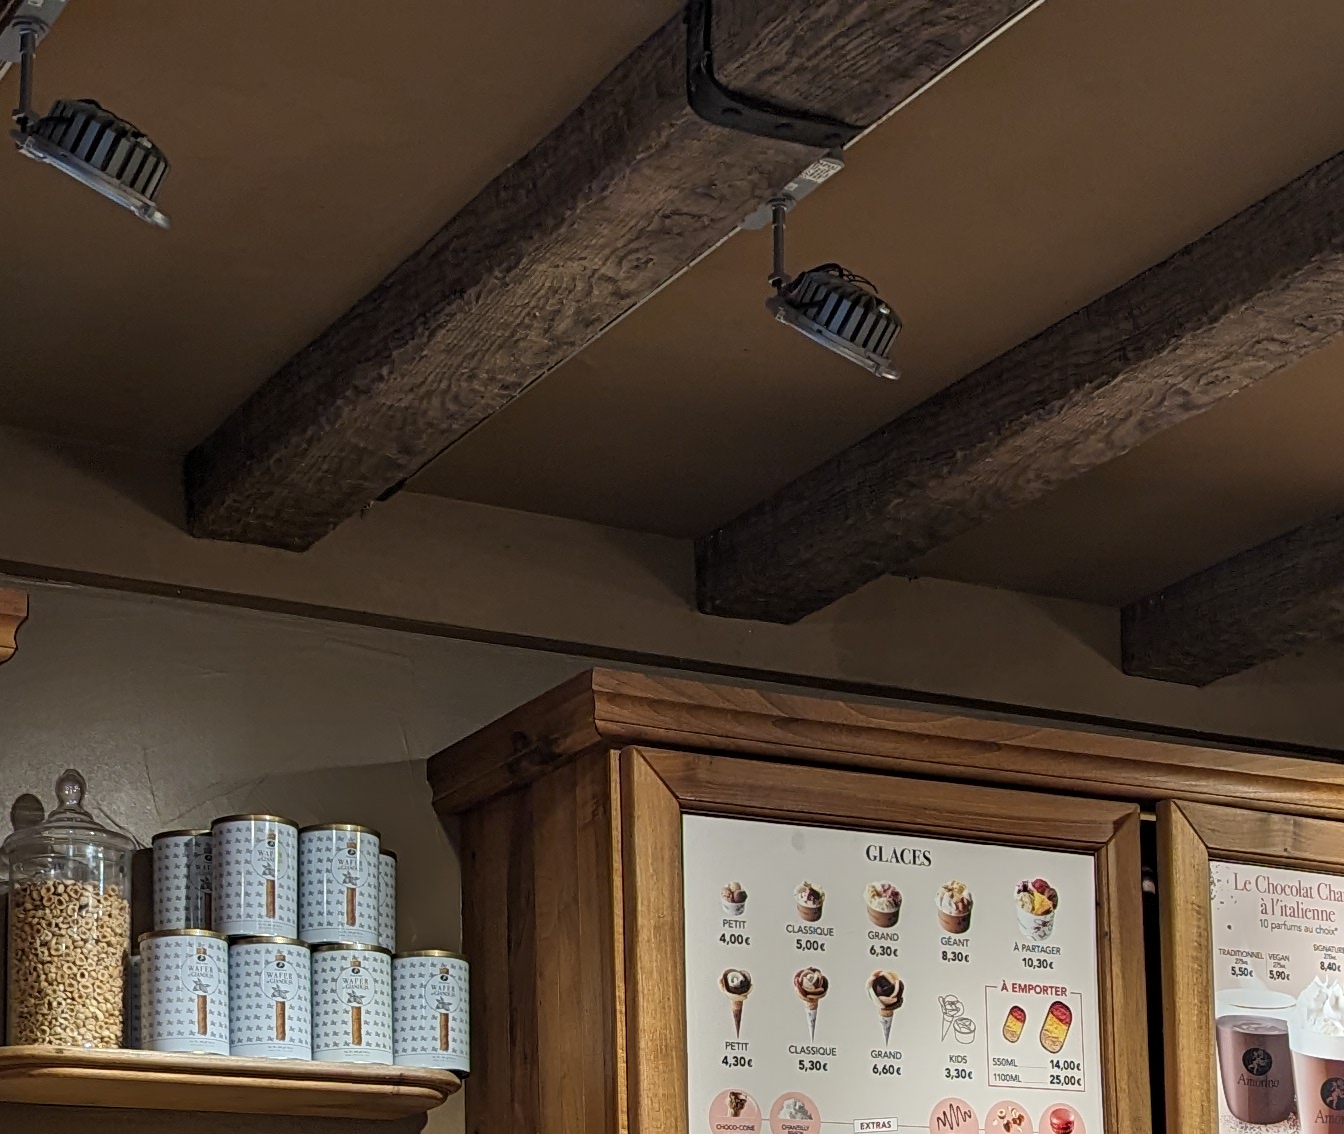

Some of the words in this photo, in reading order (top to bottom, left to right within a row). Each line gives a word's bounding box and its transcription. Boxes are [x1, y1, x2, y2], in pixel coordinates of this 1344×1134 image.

[865, 844, 932, 867] GLACES
[1233, 872, 1252, 892] Le
[1255, 875, 1314, 899] Chocolat
[1260, 897, 1268, 916] à
[1271, 897, 1336, 923] l'italienne
[722, 918, 747, 930] PETIT
[1259, 919, 1269, 929] 10
[1270, 921, 1302, 932] parfums
[1304, 925, 1313, 934] au
[785, 924, 835, 937] CLASSIQUE
[867, 930, 900, 942] GRAND
[940, 936, 970, 948] GÉANT
[1021, 944, 1061, 956] PARTAGER
[1268, 953, 1290, 962] VEGAN
[188, 965, 214, 973] WAFER
[266, 972, 293, 980] WAFER
[342, 977, 369, 986] WAFER
[431, 983, 456, 992] WAFER
[1000, 980, 1009, 993] À
[1012, 983, 1068, 998] EMPORTER
[725, 1041, 749, 1052] PETIT
[788, 1045, 837, 1057] CLASSIQUE
[870, 1049, 902, 1060] GRAND
[949, 1054, 968, 1064] KIDS
[1237, 1073, 1280, 1089] Amorino
[860, 1121, 892, 1131] EXTRAS
